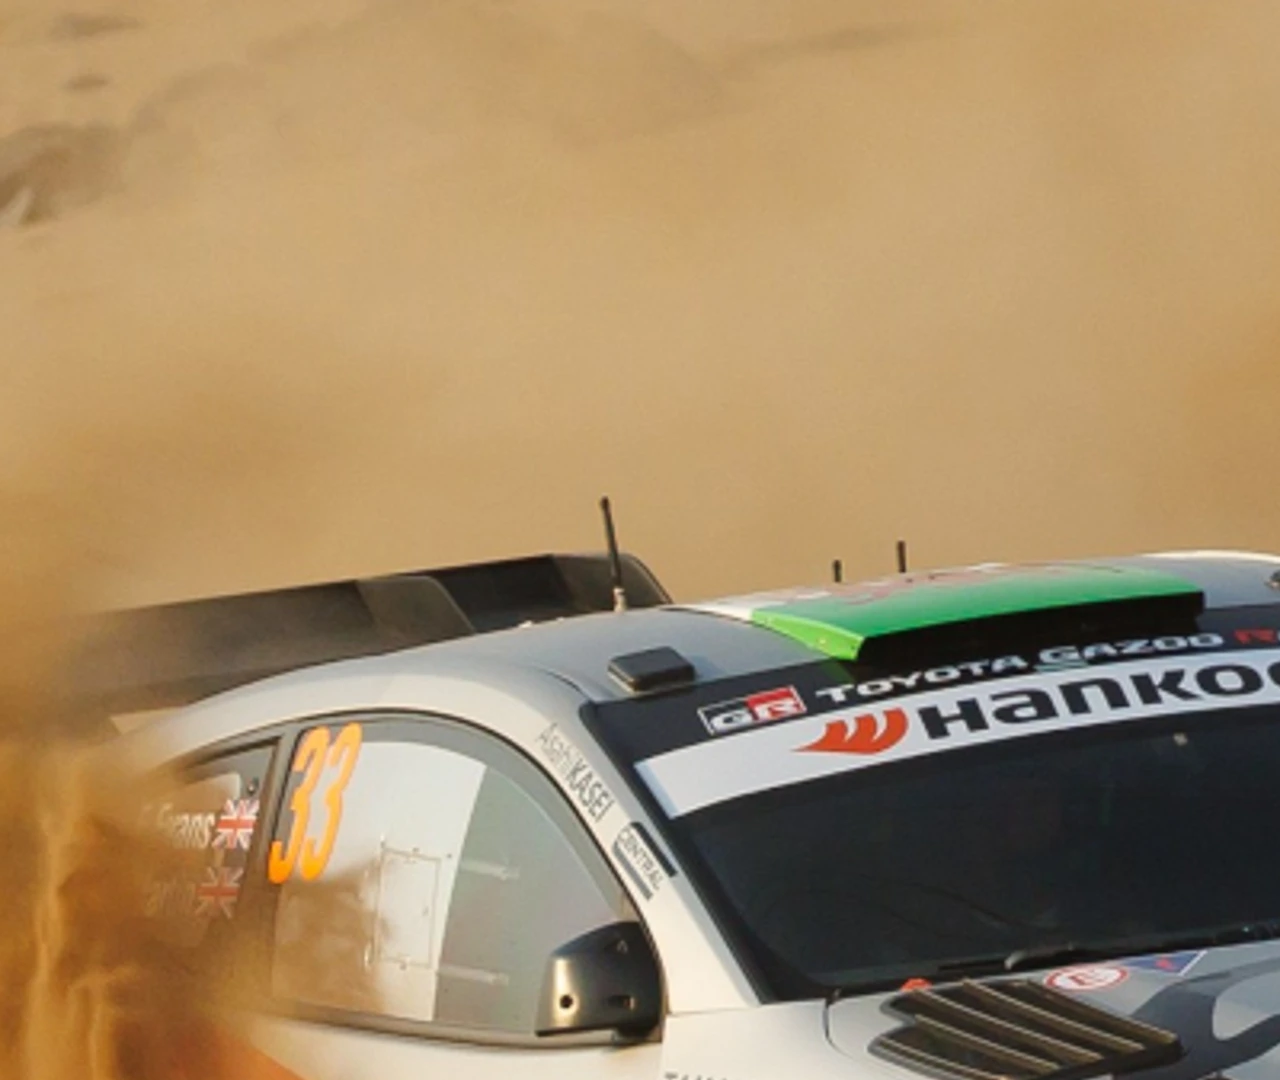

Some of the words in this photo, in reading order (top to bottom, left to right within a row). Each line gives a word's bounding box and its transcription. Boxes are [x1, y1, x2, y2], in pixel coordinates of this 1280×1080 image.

[817, 655, 1027, 702] TOYOTA
[1036, 632, 1224, 665] GAZOO
[268, 721, 363, 884] 33
